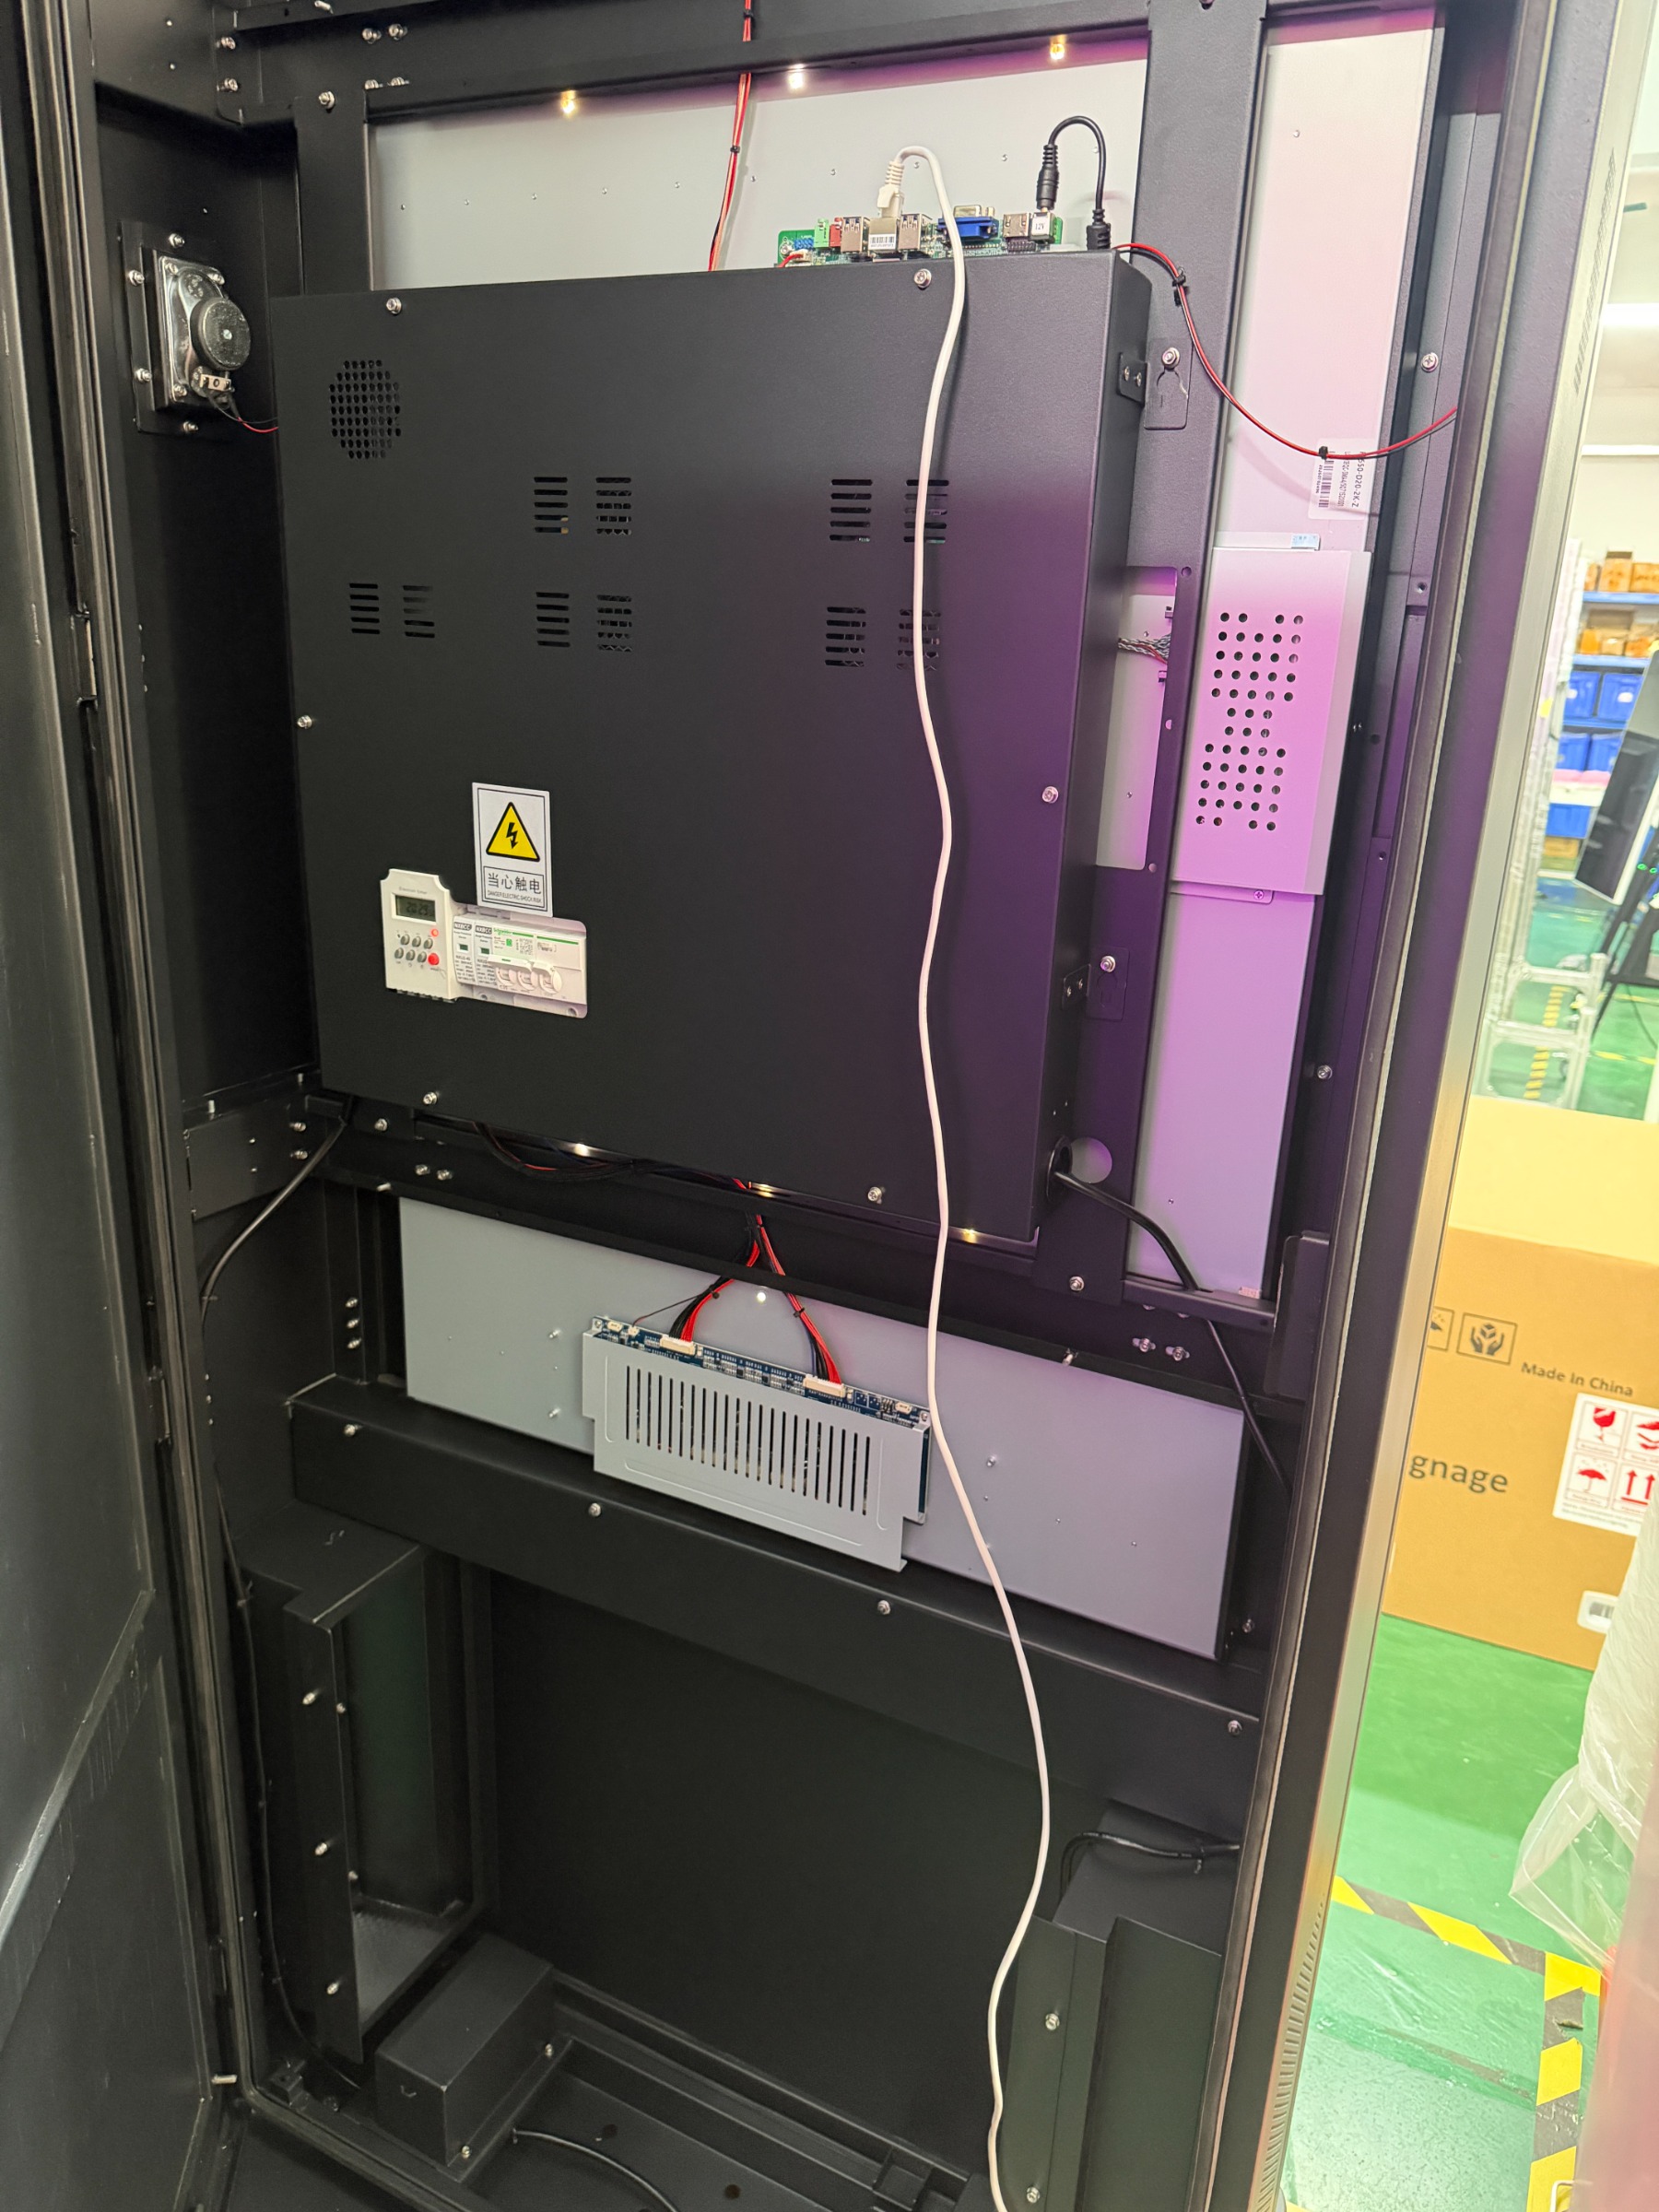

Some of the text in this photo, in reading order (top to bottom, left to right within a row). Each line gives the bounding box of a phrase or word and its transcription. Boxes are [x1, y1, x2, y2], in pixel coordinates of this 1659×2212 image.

[488, 872, 542, 895] 当心触电
[1521, 1361, 1565, 1382] Made
[1589, 1376, 1634, 1397] China
